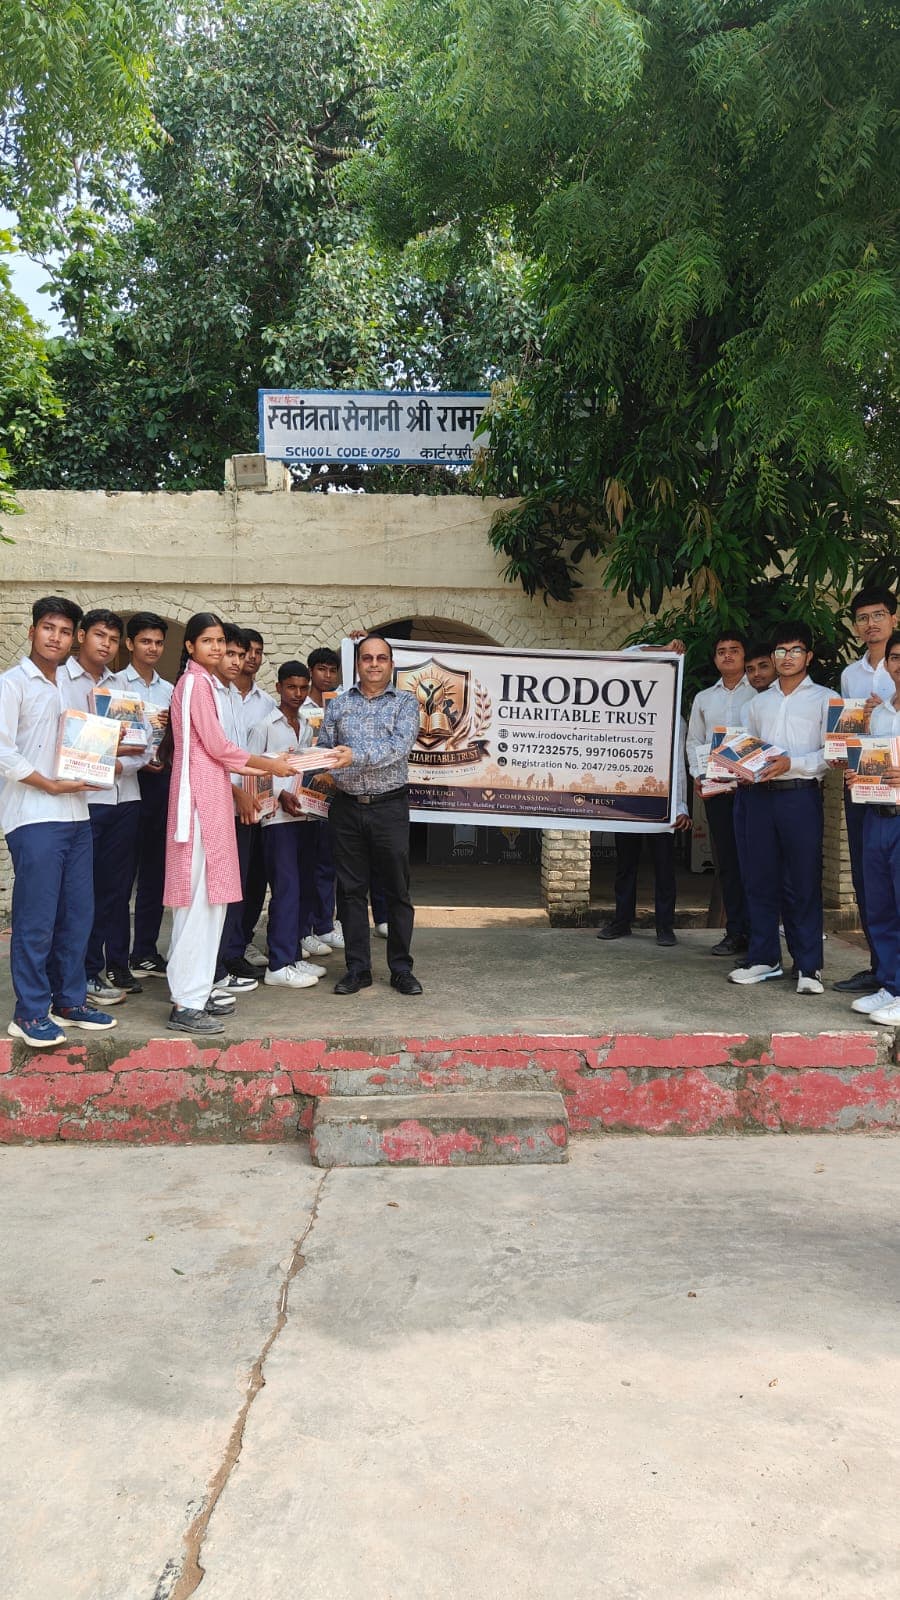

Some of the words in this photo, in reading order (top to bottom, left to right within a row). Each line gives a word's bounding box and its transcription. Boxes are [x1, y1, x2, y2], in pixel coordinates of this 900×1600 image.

[267, 400, 341, 431] स्वतंत्रता
[342, 400, 402, 432] सेनानी
[406, 400, 433, 432] श्री
[285, 446, 332, 458] SCHOOL
[499, 674, 659, 708] IRODOV
[498, 706, 601, 723] CHARITABLE
[605, 711, 658, 725] TRUST
[512, 730, 653, 746] www.irodovcharitabletrust.org
[408, 752, 456, 763] CHARITABLE
[458, 749, 479, 761] TRUST
[512, 744, 582, 757] 9717232575,
[585, 747, 654, 759] 9971060575
[511, 759, 563, 771] Registration
[565, 761, 579, 770] No.
[581, 762, 654, 773] 2047/29.05.2026
[409, 788, 456, 797] KNOWLEDGE
[499, 793, 550, 802] COMPASSION
[591, 798, 616, 806] TRUST
